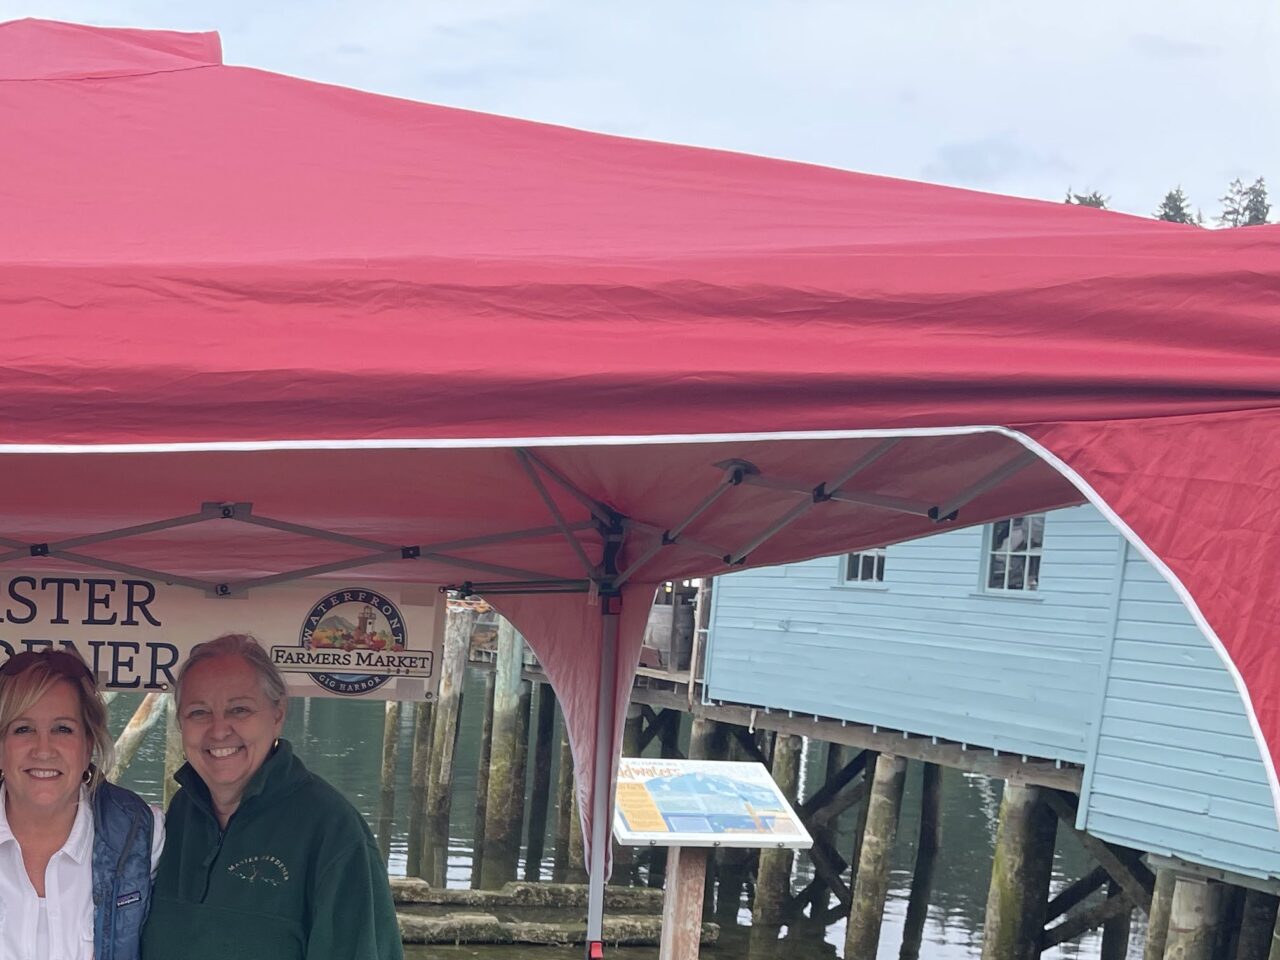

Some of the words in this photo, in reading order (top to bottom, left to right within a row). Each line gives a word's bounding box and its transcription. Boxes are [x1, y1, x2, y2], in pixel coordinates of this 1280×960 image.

[304, 592, 403, 642] WATERFRONT
[274, 650, 352, 666] FARMERS
[355, 652, 429, 669] MARKET
[319, 673, 336, 688] GIG
[339, 676, 383, 692] HARBOR
